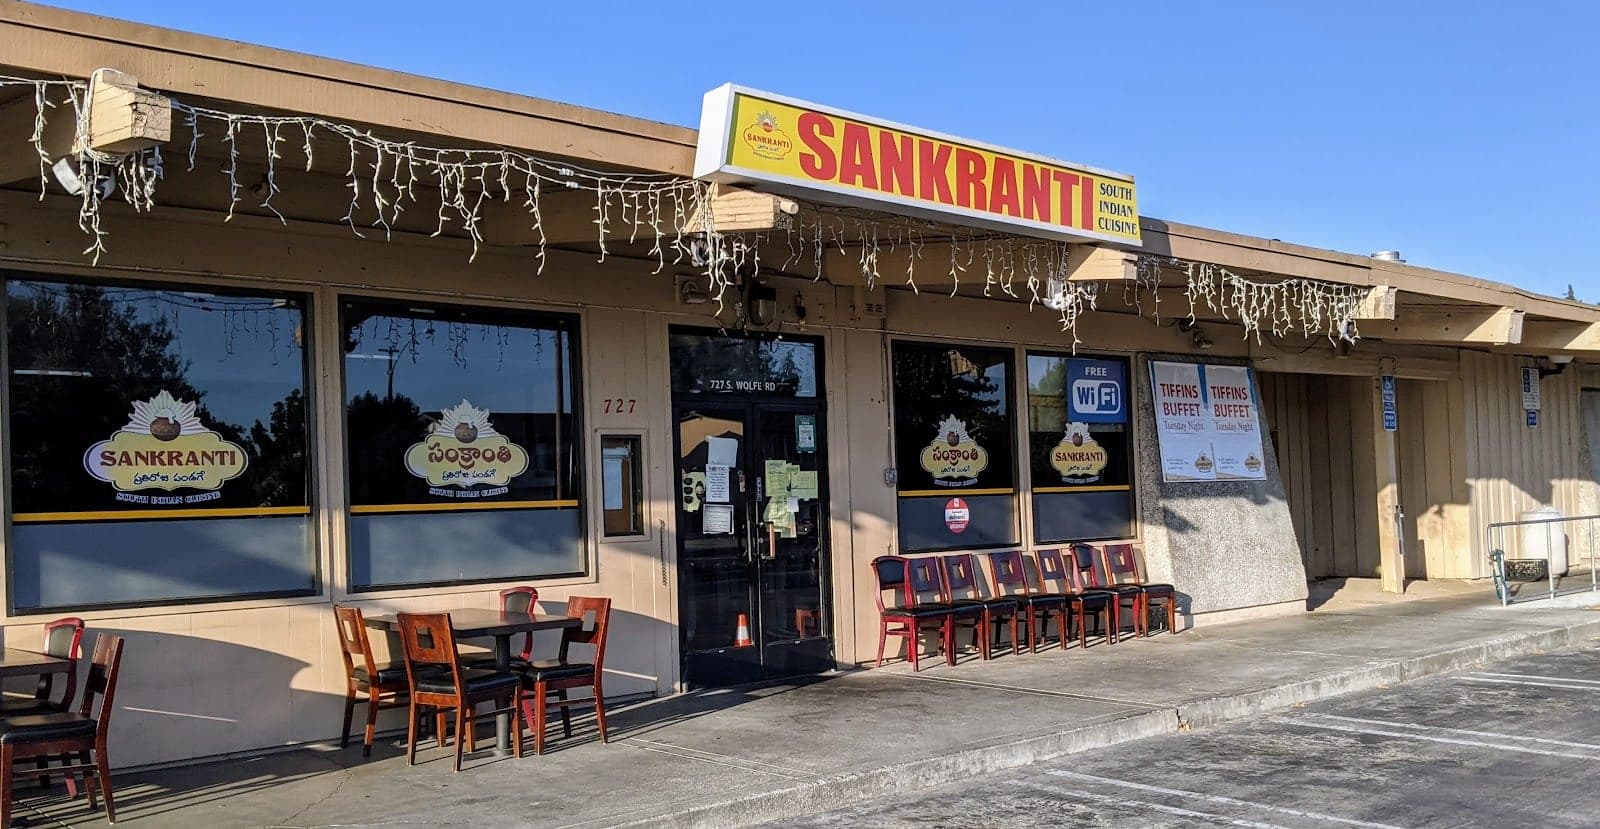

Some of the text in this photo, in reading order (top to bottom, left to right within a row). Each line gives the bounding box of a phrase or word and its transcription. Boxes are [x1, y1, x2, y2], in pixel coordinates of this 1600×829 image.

[747, 133, 790, 149] SANKRANTI
[797, 112, 1094, 231] SANKRANTI
[1100, 183, 1132, 200] SOUTH
[1099, 200, 1133, 218] INDIAN
[1098, 217, 1137, 235] CUISINE
[1084, 366, 1108, 377] FREE
[709, 380, 725, 389] 727
[736, 381, 762, 391] WOLFE
[765, 382, 776, 391] RD
[1160, 383, 1199, 399] TIFFINS
[1210, 385, 1248, 400] TIFFINS
[604, 399, 636, 415] 727
[1163, 402, 1201, 417] BUFFET
[1214, 404, 1250, 418] BUFFET
[1163, 420, 1204, 433] Tuesday Night
[1214, 421, 1253, 433] Tuesday Night
[100, 450, 236, 467] SANKRANTI
[428, 442, 512, 470] సంక్రాంతి
[1055, 451, 1103, 462] SANKRANTI
